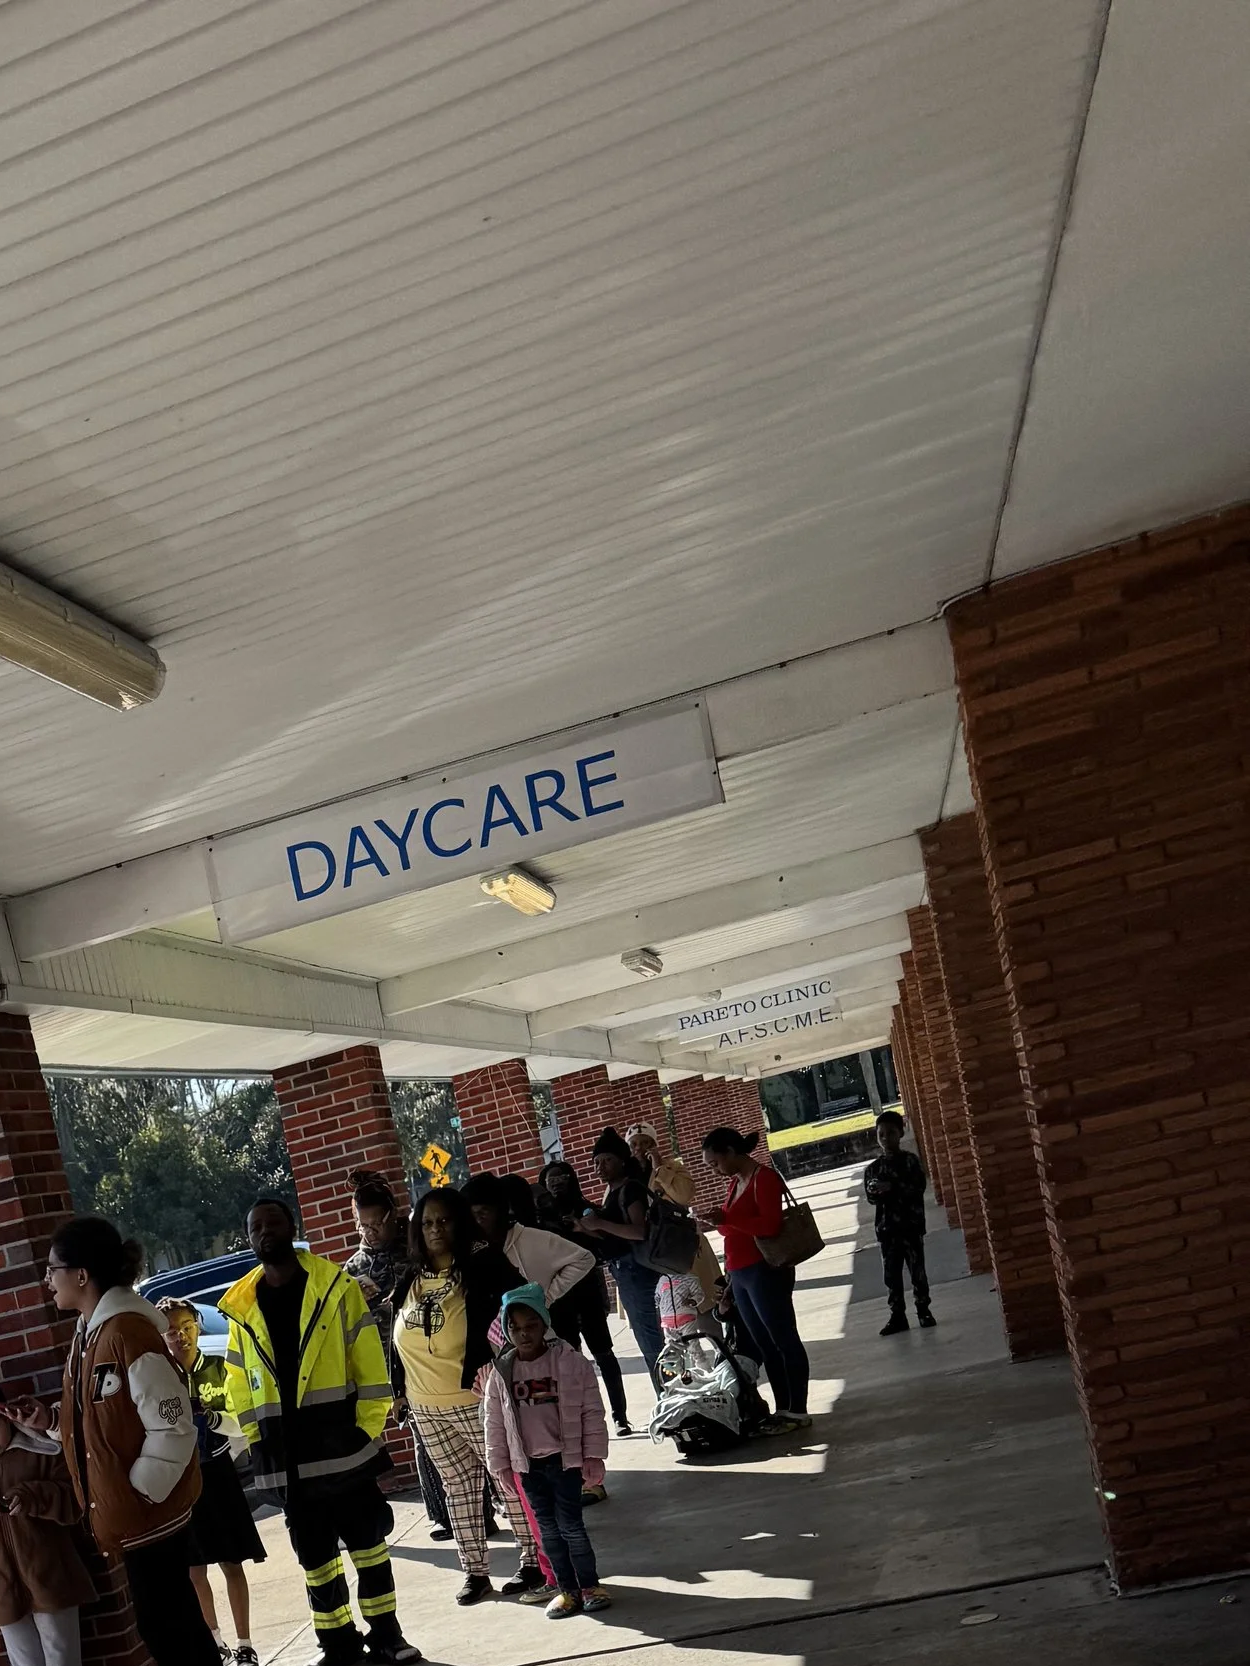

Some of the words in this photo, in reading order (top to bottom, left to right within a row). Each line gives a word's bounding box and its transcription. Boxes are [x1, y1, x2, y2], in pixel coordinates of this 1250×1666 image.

[286, 750, 625, 902] DAYCARE
[678, 1000, 756, 1031] PARETO
[760, 980, 832, 1009] CLINIC
[718, 1005, 839, 1048] A.F.S.C.M.E.
